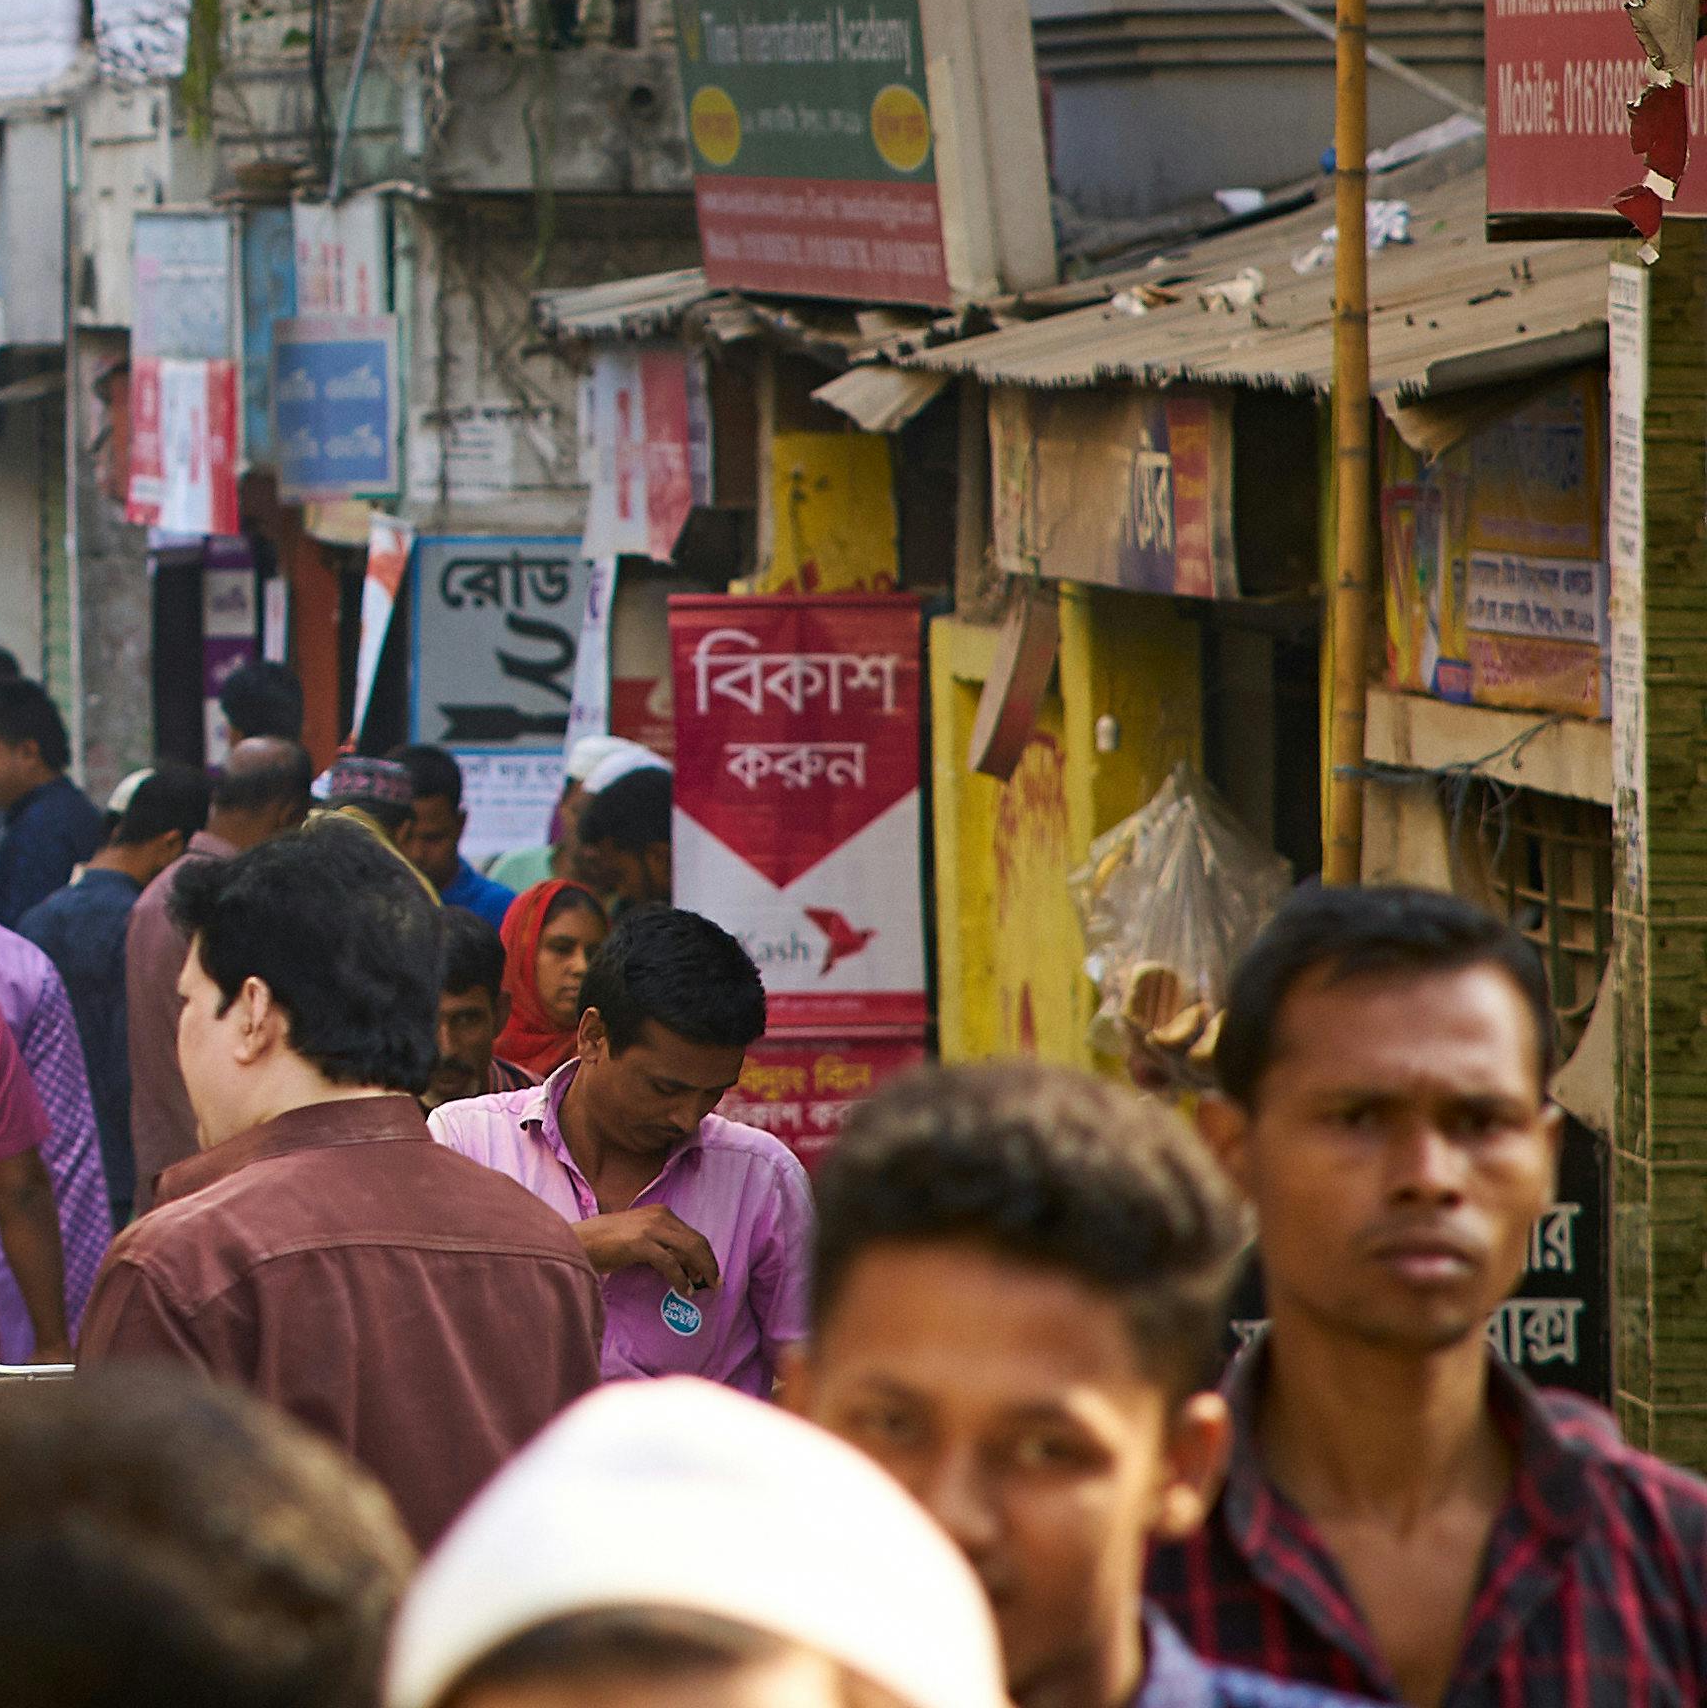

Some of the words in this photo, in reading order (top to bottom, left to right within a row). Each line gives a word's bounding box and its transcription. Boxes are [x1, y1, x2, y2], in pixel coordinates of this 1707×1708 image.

[837, 5, 912, 76] Academy
[1499, 62, 1558, 136] Mobile:
[439, 551, 573, 609] রোড
[692, 628, 899, 715] বিকাশ
[725, 742, 867, 789] করুন
[735, 932, 810, 963] Kash
